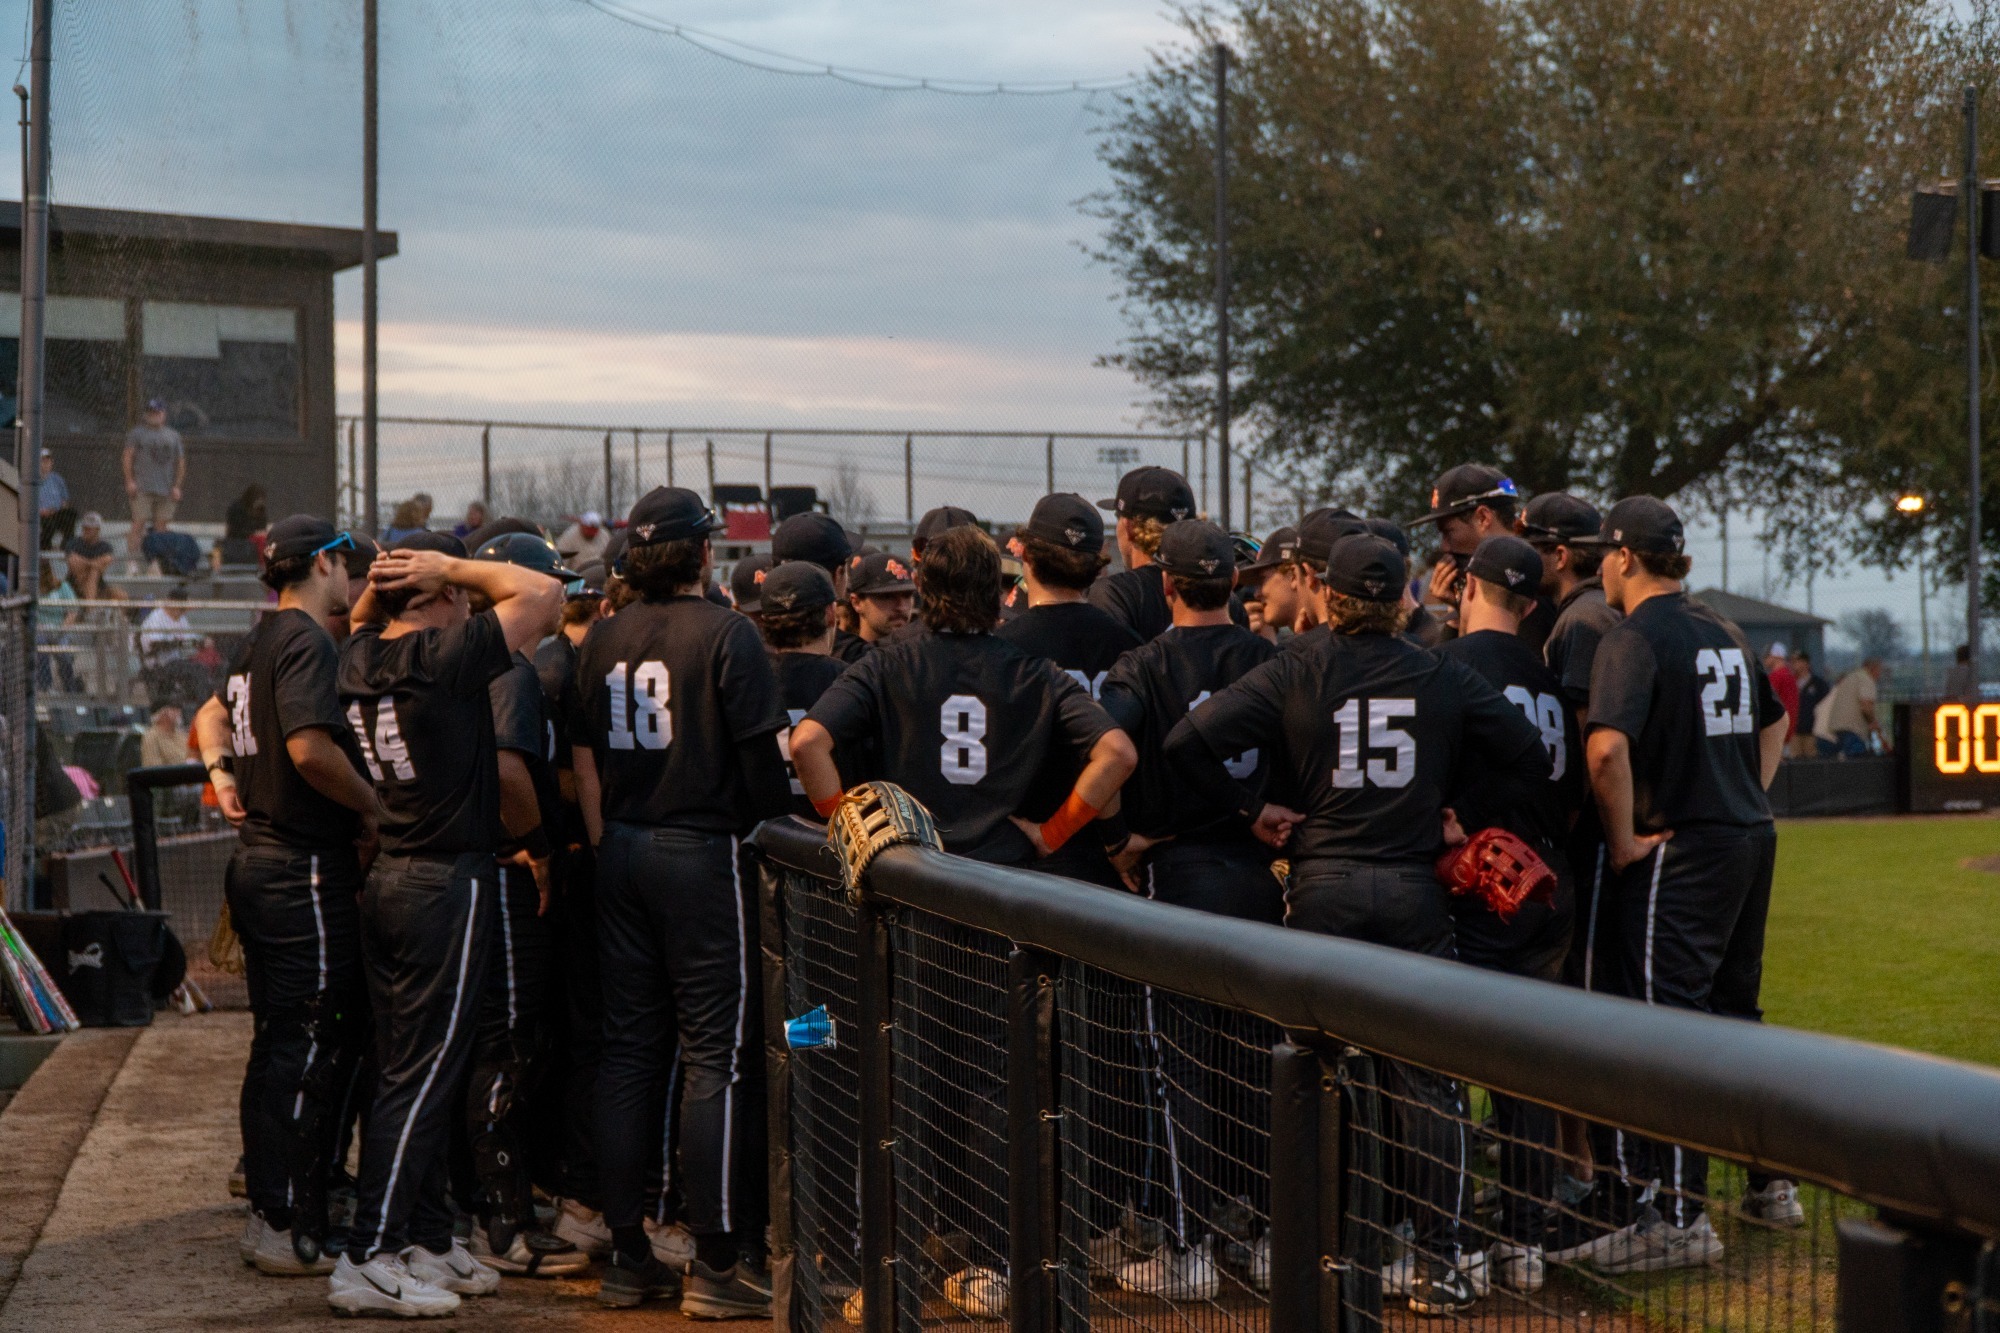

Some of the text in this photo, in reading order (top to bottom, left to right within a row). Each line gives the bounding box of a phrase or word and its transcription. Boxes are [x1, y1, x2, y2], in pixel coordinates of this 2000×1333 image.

[227, 671, 258, 757] 31
[605, 661, 673, 750] 18
[1695, 648, 1754, 737] 27
[346, 695, 416, 781] 14
[940, 694, 987, 785] 8
[1332, 698, 1416, 788] 15
[1935, 703, 2000, 774] 00
